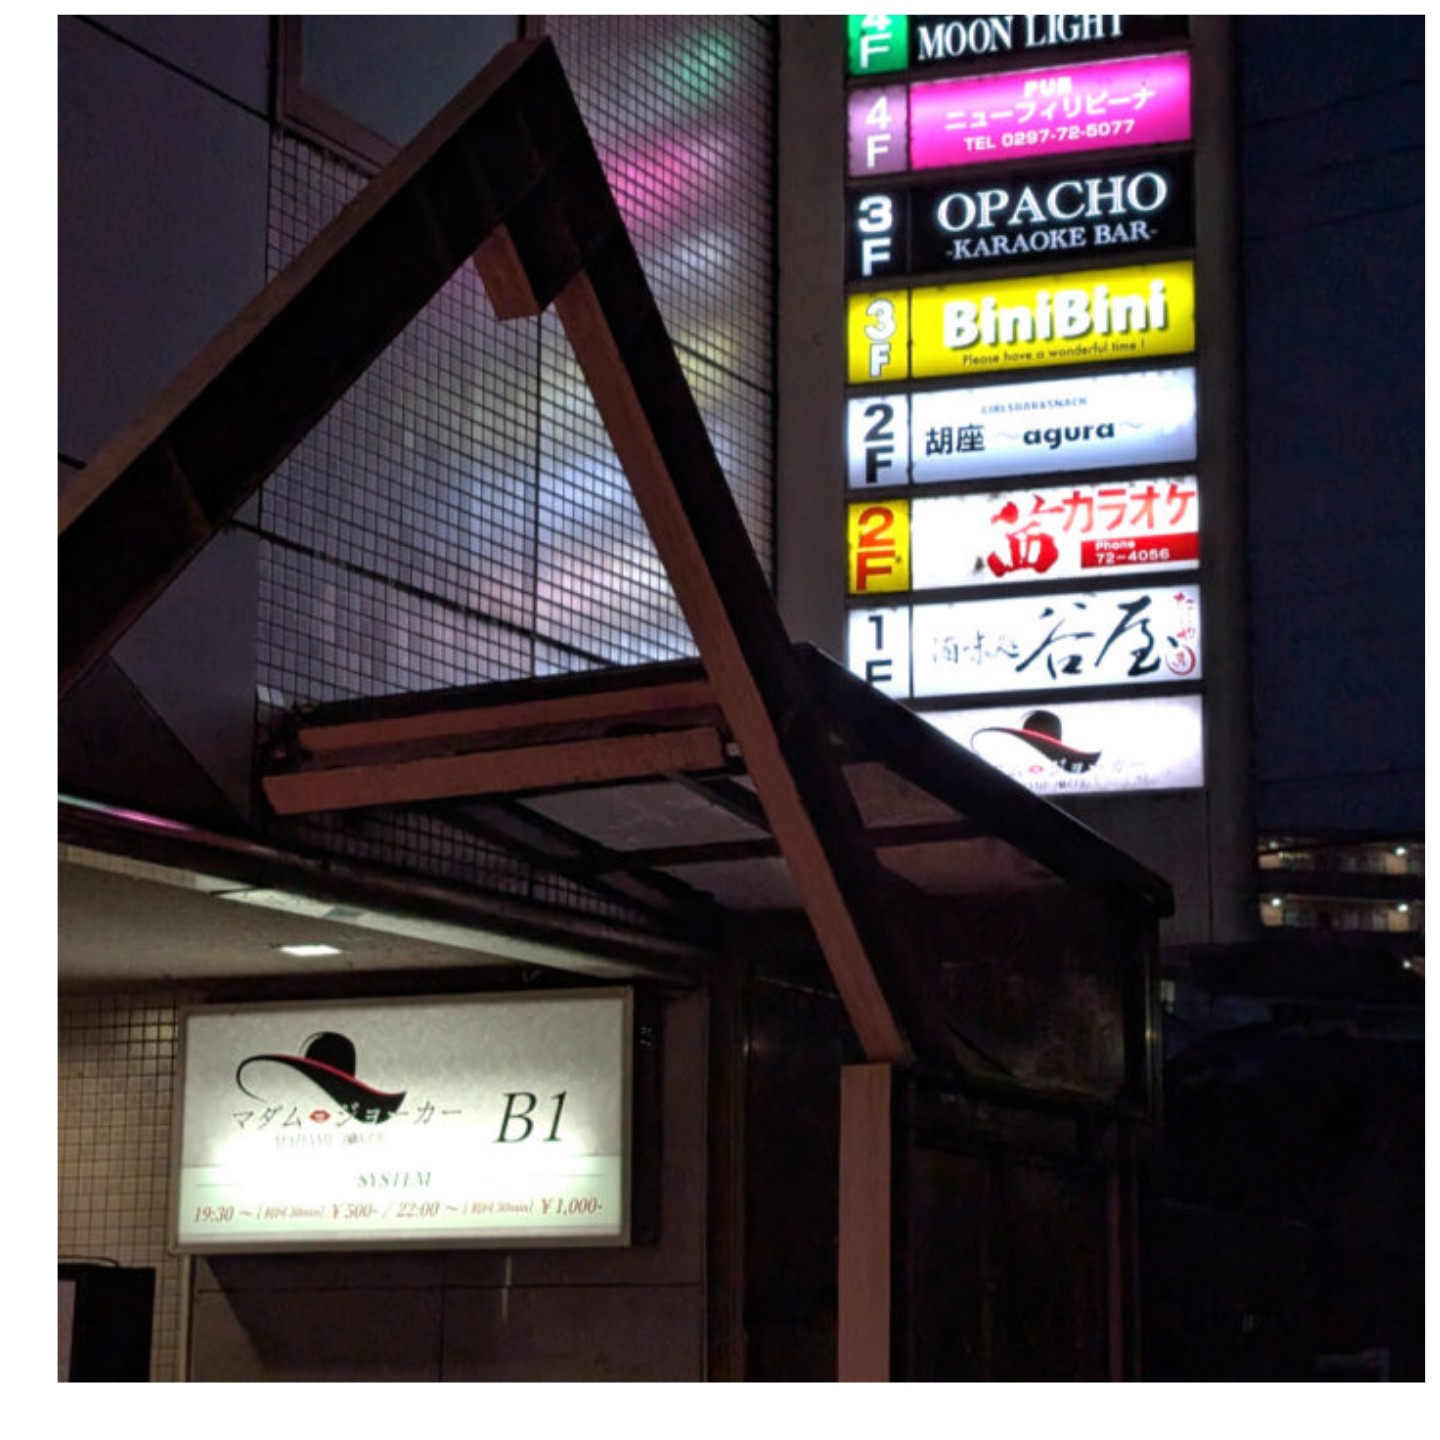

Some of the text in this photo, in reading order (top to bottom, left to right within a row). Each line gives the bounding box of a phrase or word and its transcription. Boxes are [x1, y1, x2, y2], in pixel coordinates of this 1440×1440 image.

[917, 15, 1125, 62] MOON LIGHT
[1023, 77, 1073, 99] PUB
[865, 96, 893, 169] 4F
[963, 136, 996, 152] TEL
[937, 172, 1168, 232] OPACHO
[857, 195, 893, 277] 3F
[864, 298, 896, 378] 3F
[942, 279, 1169, 351] BiniBini
[962, 353, 1000, 366] Please
[1004, 349, 1033, 362] have
[1048, 342, 1108, 359] wonderful
[863, 403, 894, 483] 2F
[925, 424, 985, 456] 胡座
[1060, 483, 1196, 533] カラオケ
[855, 506, 896, 591] 2F
[1094, 539, 1136, 552] Phone
[1016, 595, 1172, 680] 谷屋
[493, 1090, 568, 1144] B1
[356, 1171, 432, 1189] SYSTEM
